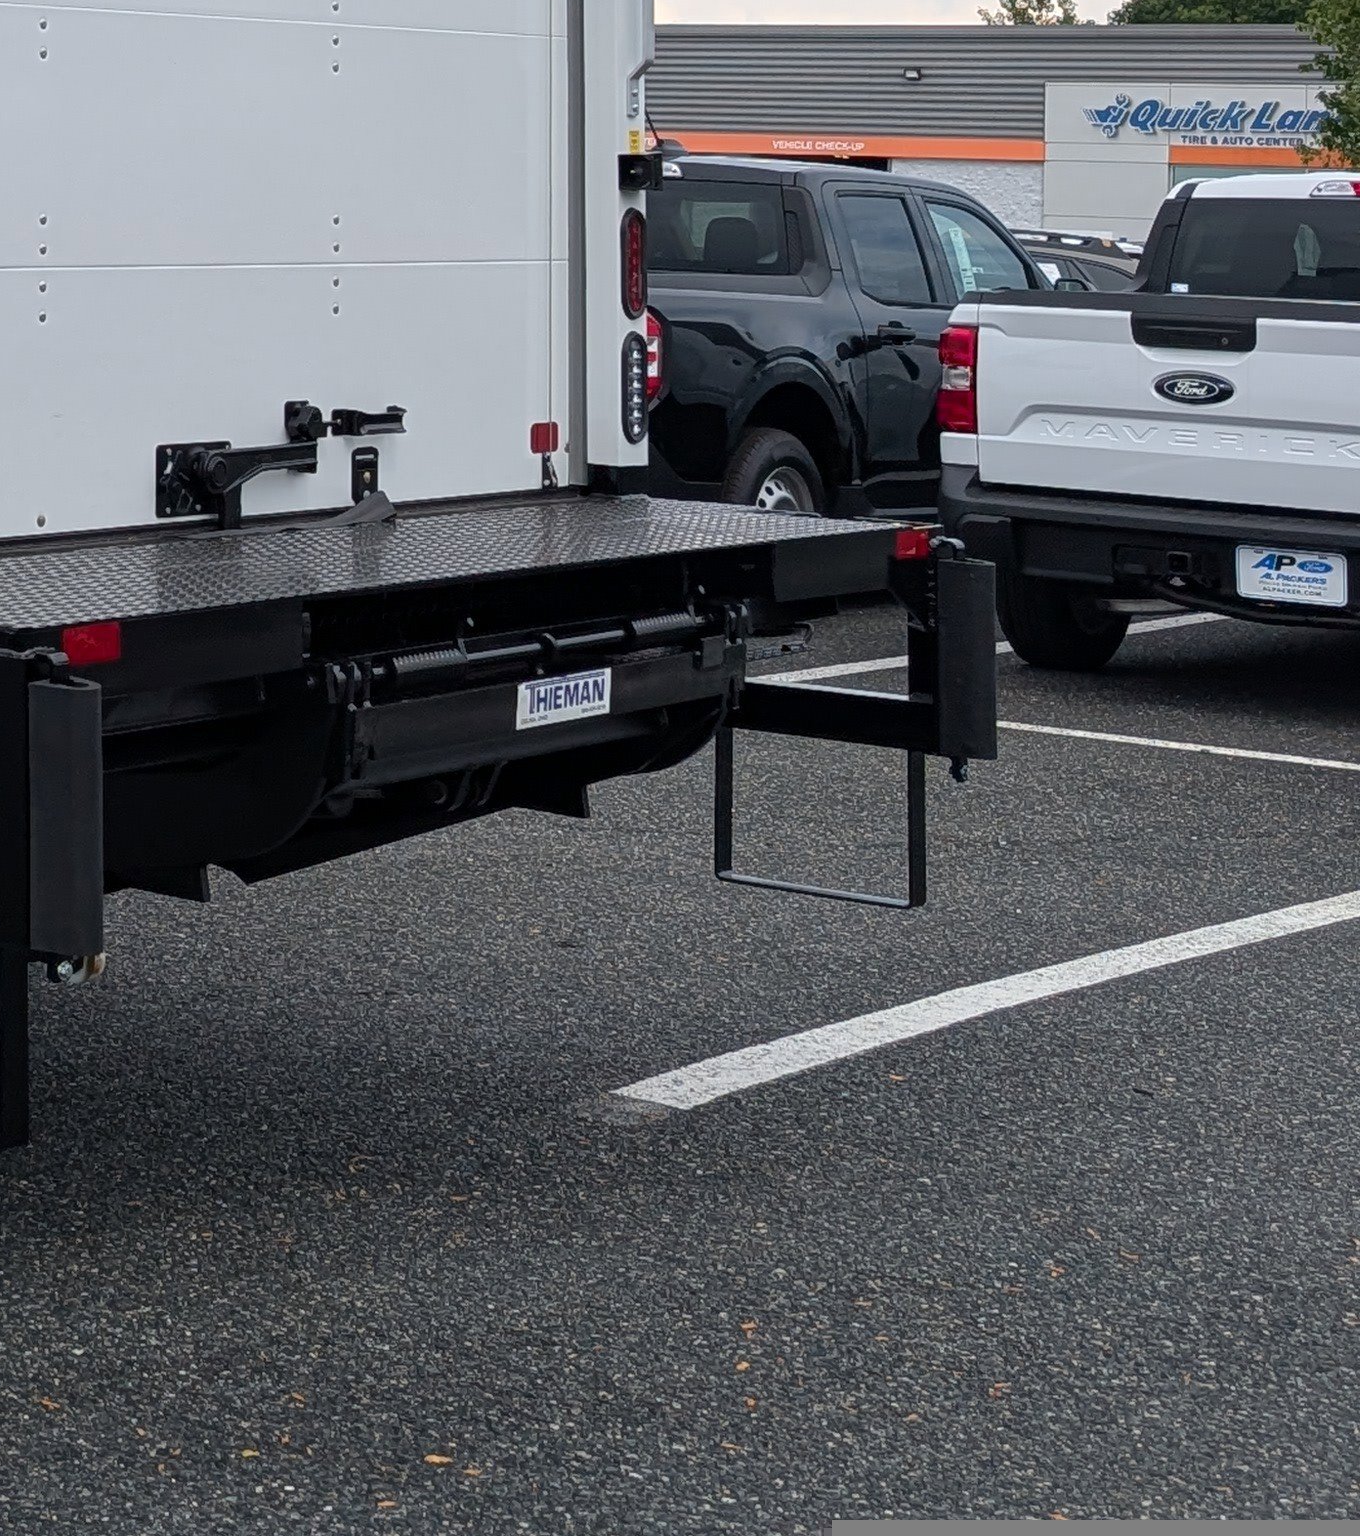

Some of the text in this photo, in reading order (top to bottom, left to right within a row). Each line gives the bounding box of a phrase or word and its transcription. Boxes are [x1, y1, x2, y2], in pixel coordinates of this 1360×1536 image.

[1129, 99, 1334, 135] Quick Lan
[1180, 135, 1304, 147] TIRE & AUTO CENTER
[1039, 417, 1360, 461] MAVERICK
[1251, 553, 1297, 571] AP
[524, 671, 606, 715] THIEMAN
